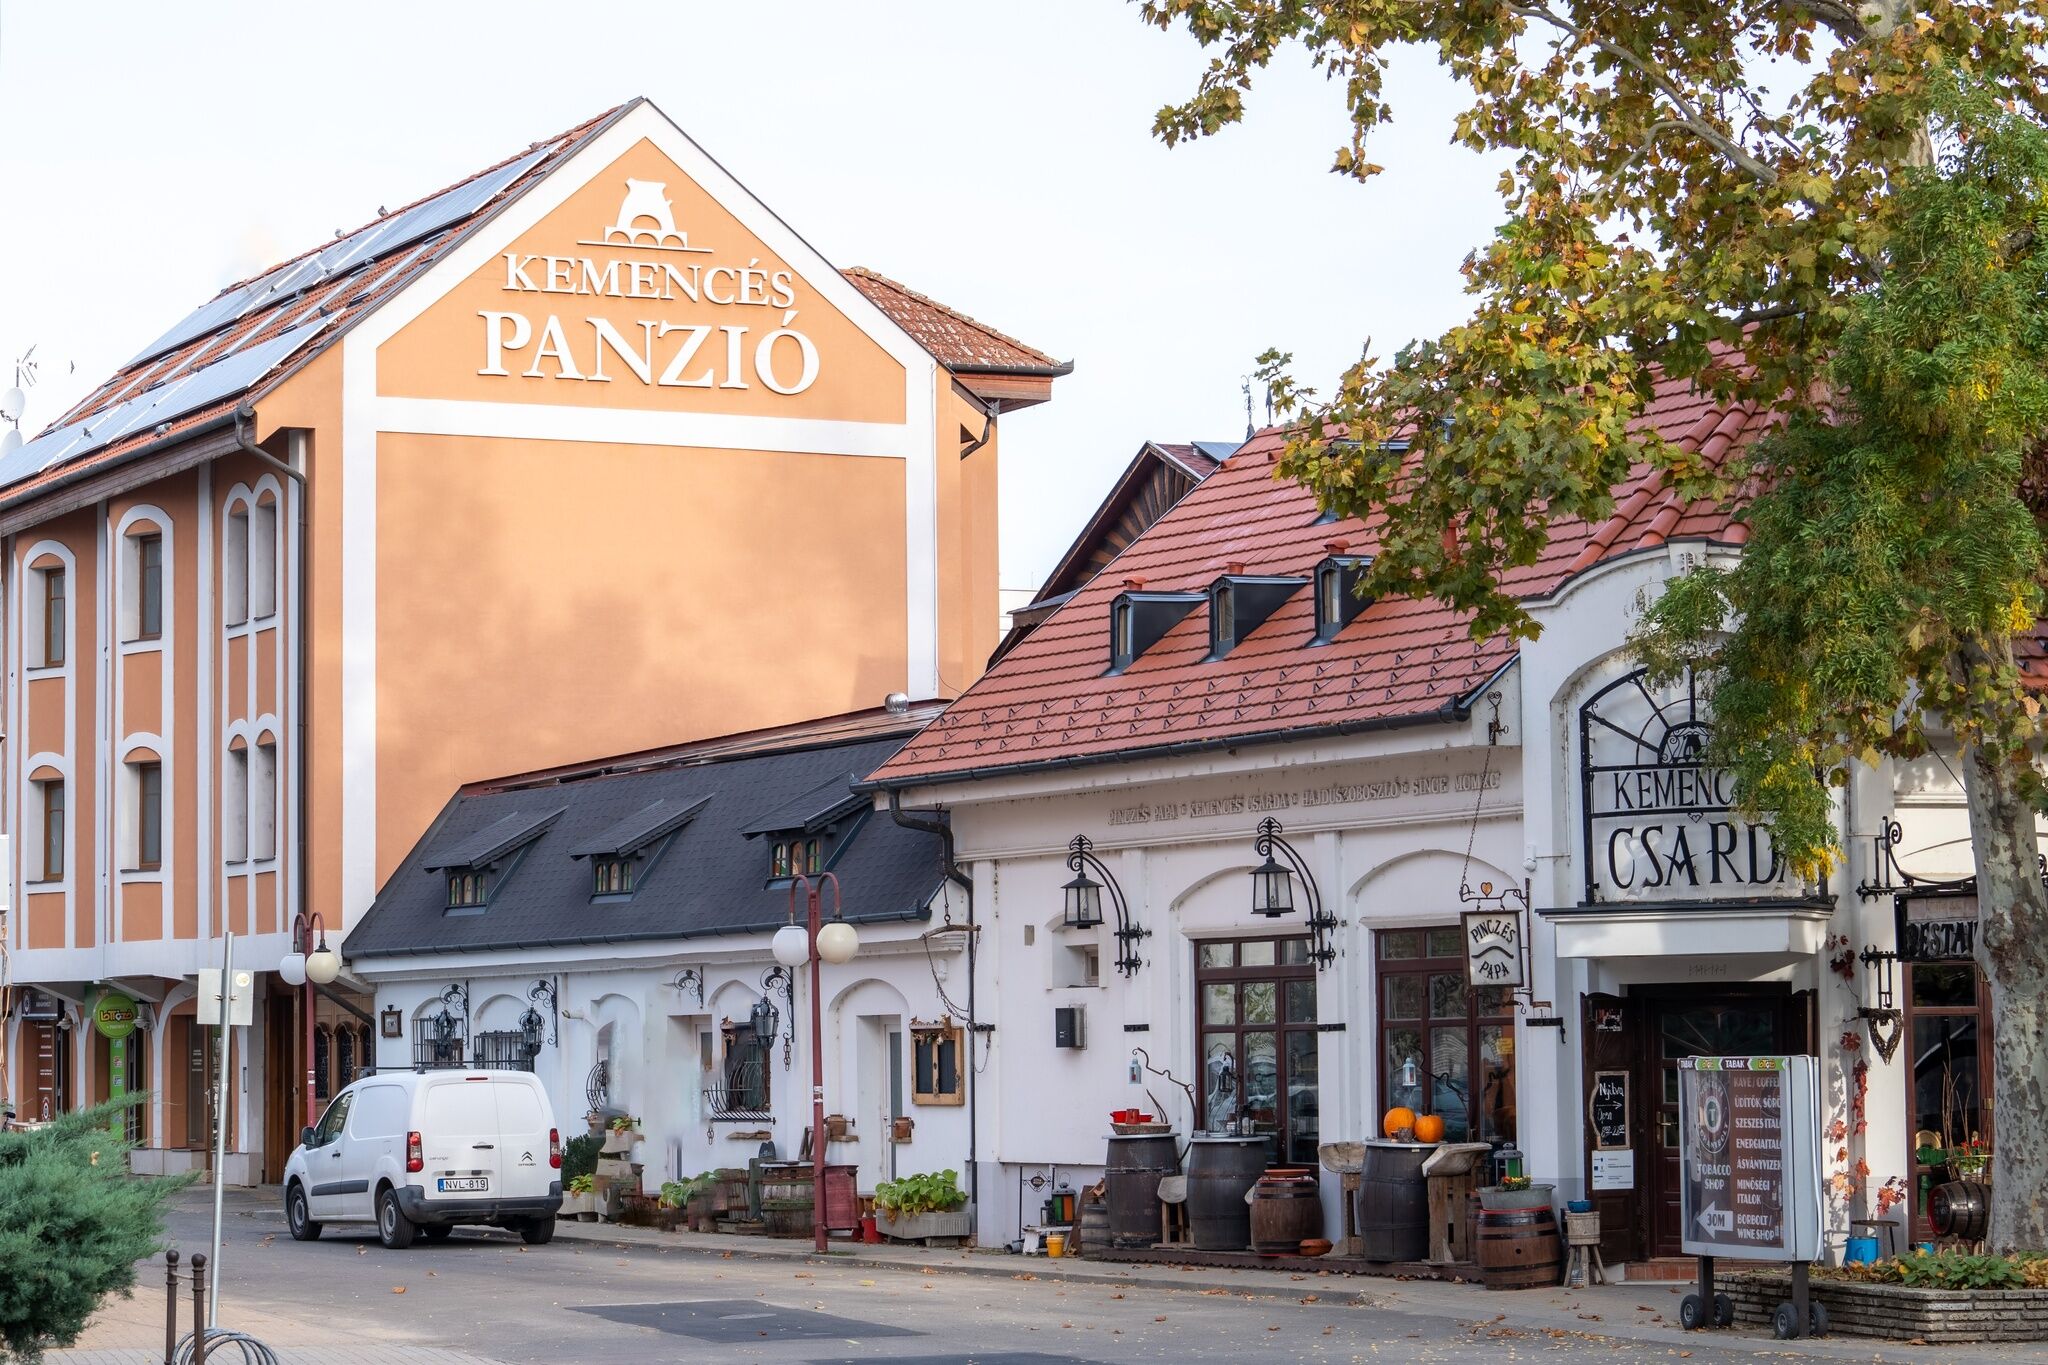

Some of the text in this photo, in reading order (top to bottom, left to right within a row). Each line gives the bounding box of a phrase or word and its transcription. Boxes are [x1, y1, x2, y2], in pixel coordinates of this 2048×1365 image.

[502, 253, 795, 308] KEMENCÉS
[477, 310, 820, 395] PANZIÓ
[1413, 776, 1449, 796] SINCE
[1614, 769, 1737, 810] KEMENC
[1470, 920, 1516, 944] PINCZÉS
[1906, 920, 1978, 956] RESTAU
[1479, 961, 1510, 979] PAPA
[1725, 1060, 1745, 1068] TABAK
[1765, 1118, 1780, 1129] ITAL
[1736, 1138, 1781, 1149] ENERGIAITAL
[1696, 1163, 1732, 1176] TOBACCO
[445, 1180, 486, 1189] NVL-819
[1704, 1178, 1725, 1191] SHOP
[1737, 1193, 1762, 1205] ITALOK
[1707, 1213, 1726, 1227] 30M
[1737, 1214, 1768, 1226] BORBOLT
[1737, 1228, 1775, 1241] WINE SHOP
